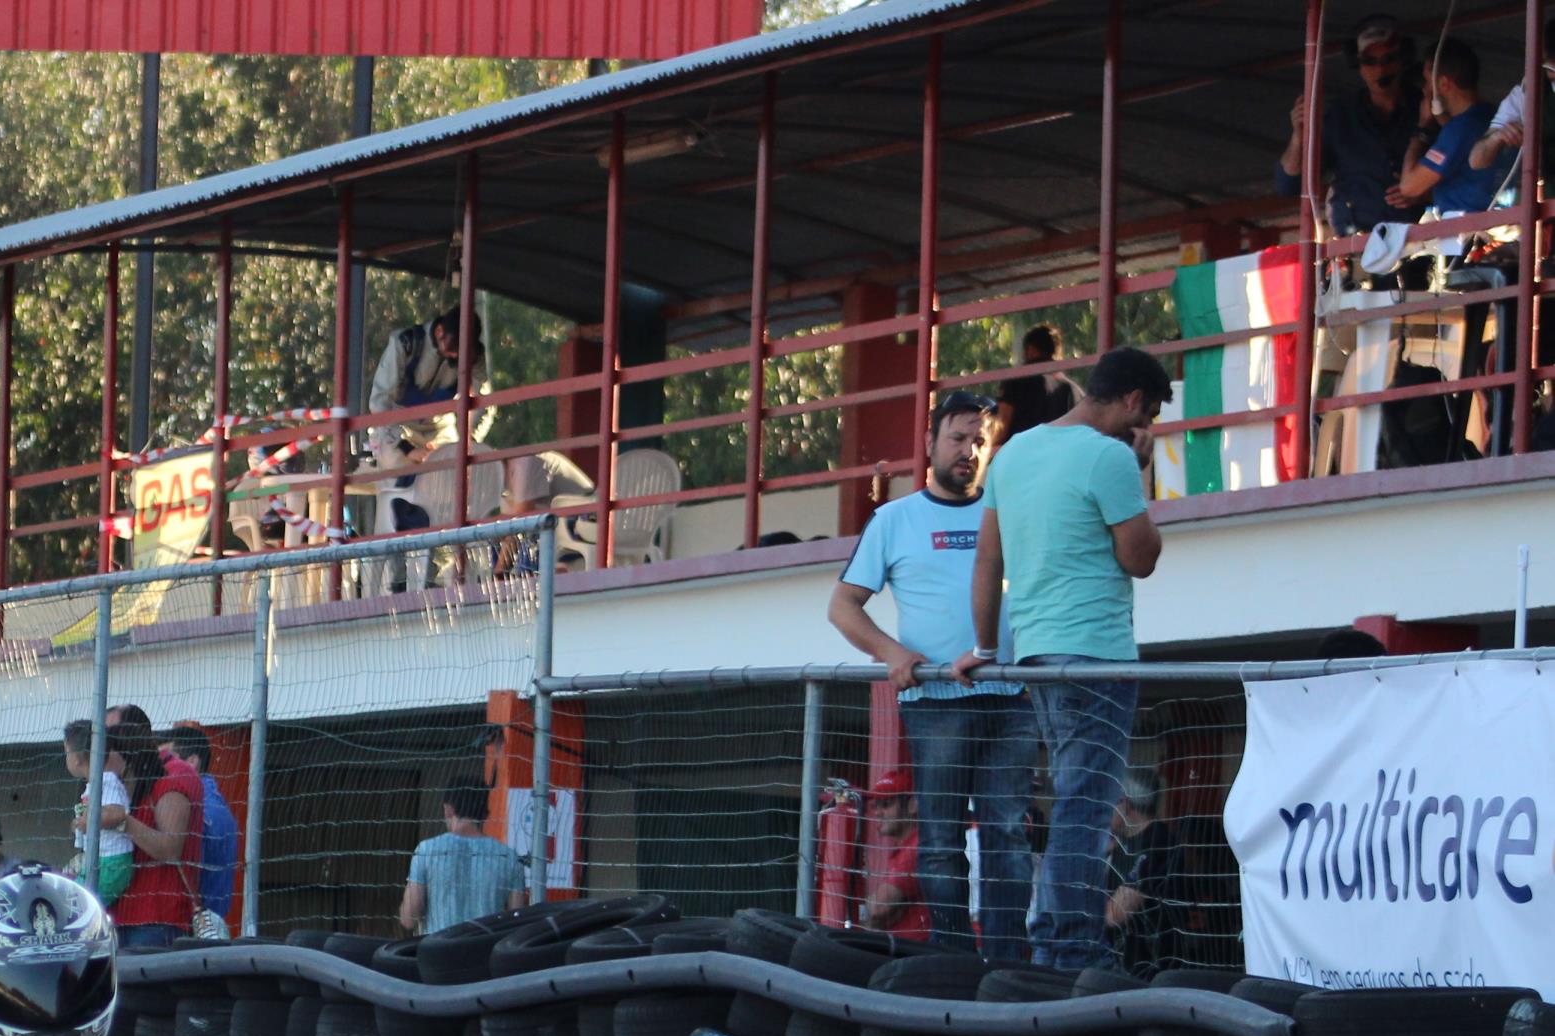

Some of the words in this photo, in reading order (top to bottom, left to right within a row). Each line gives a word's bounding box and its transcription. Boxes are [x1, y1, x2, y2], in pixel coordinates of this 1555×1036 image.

[140, 467, 212, 533] GAS
[934, 535, 978, 544] PORCH
[1279, 767, 1538, 904] multicare
[20, 932, 73, 945] SHARK
